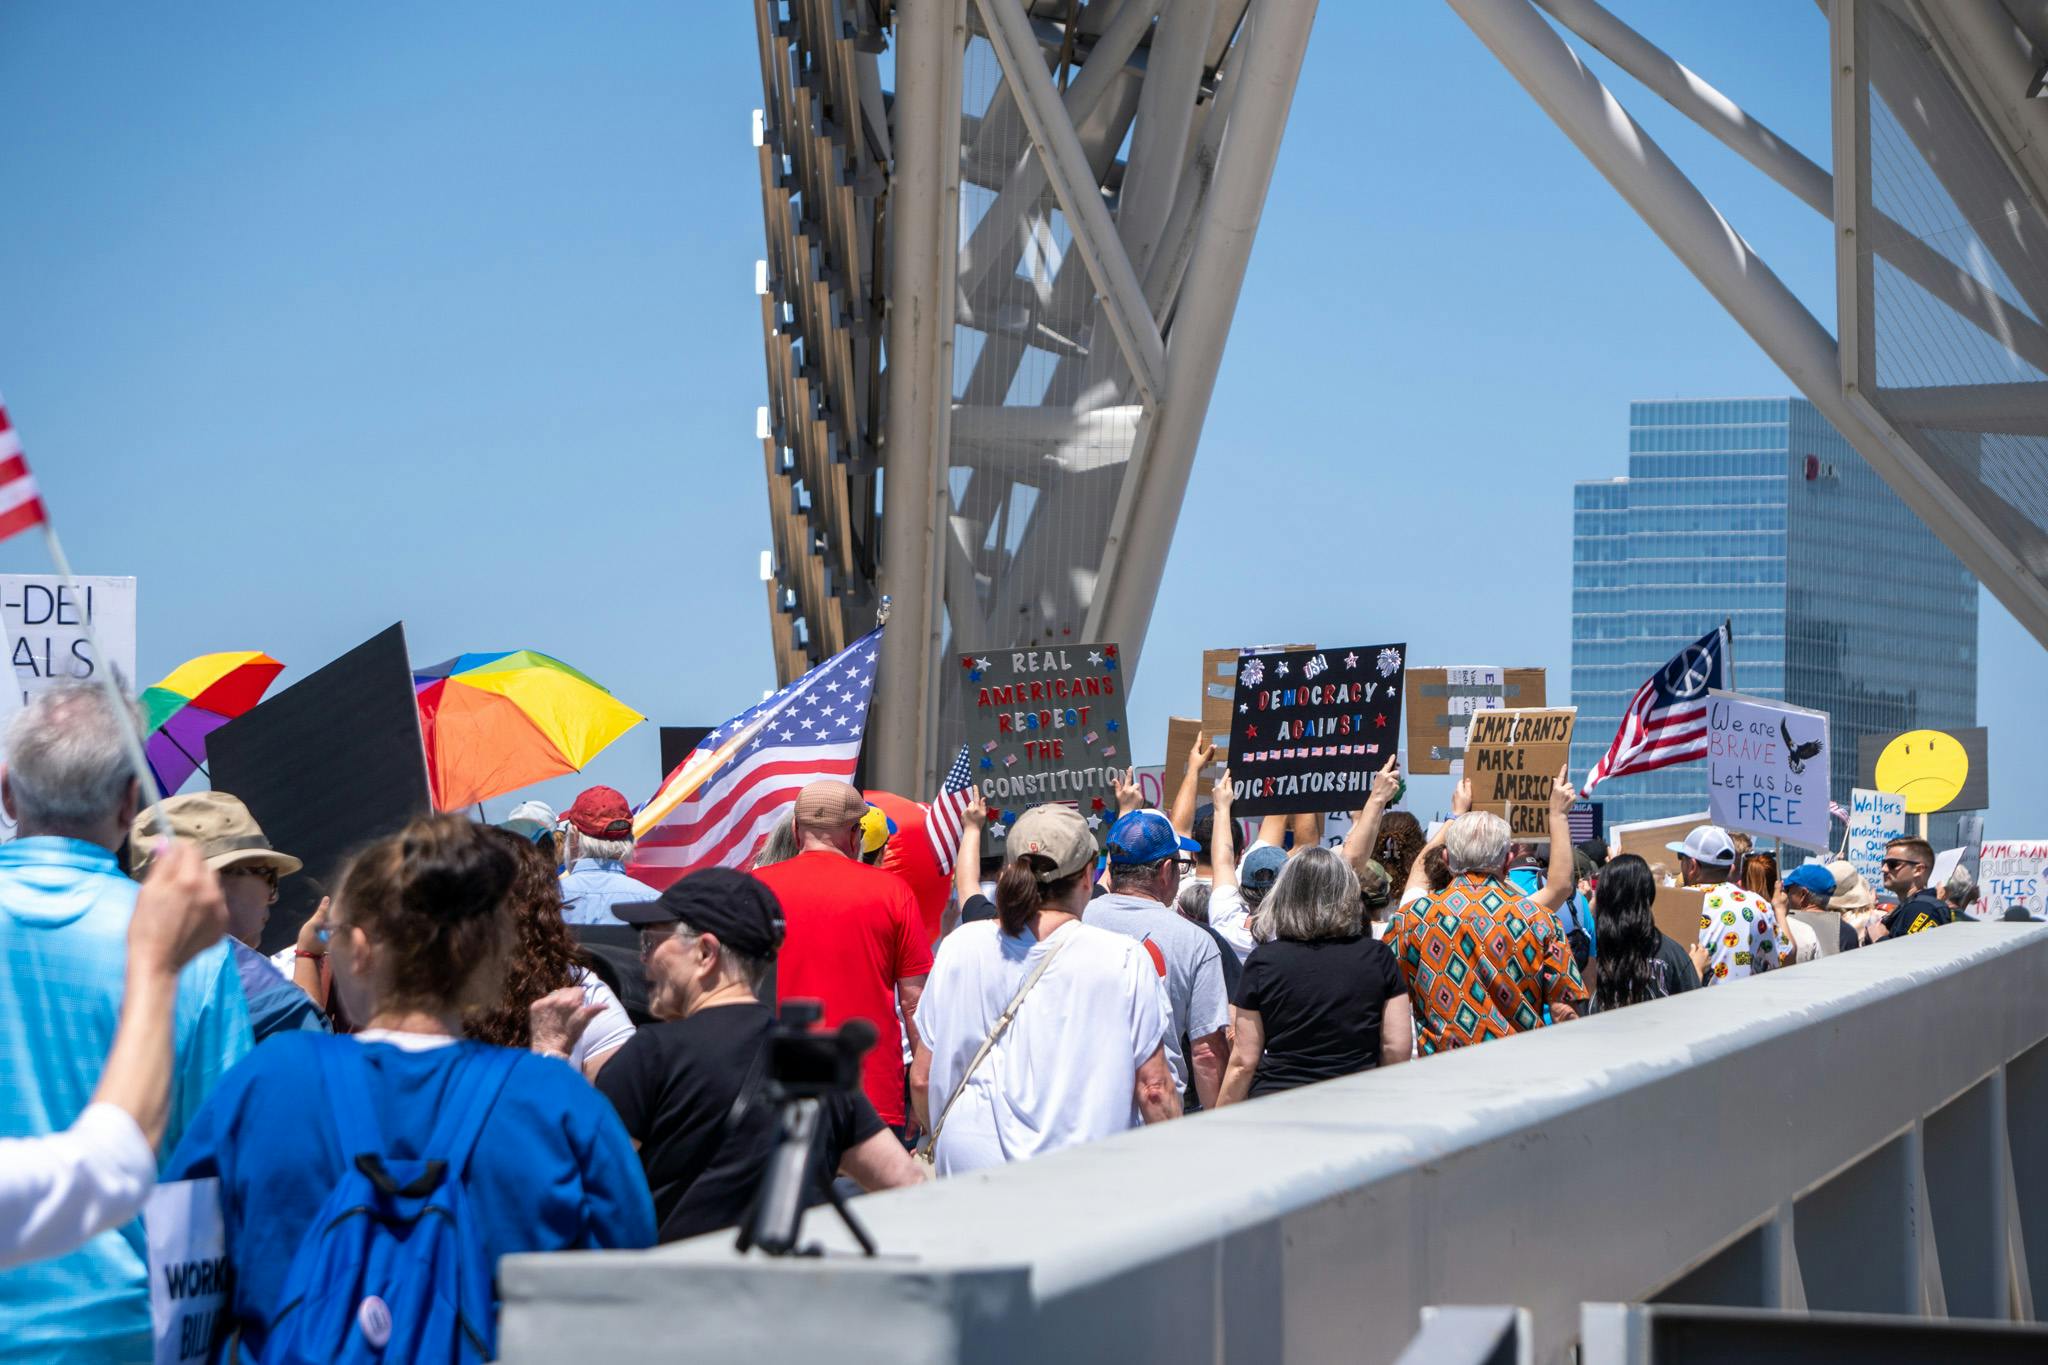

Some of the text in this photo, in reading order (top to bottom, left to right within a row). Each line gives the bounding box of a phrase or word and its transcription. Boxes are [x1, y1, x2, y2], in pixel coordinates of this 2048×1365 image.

[1011, 651, 1072, 673] REAL
[1303, 653, 1329, 680] USA
[977, 675, 1115, 708] AMERICANS
[1258, 682, 1378, 711] DEMOCRACY
[998, 705, 1091, 734] RESPECT
[1277, 714, 1363, 741] AGAINST
[1472, 715, 1571, 743] IMMIGRANTS
[1711, 702, 1776, 738] We are
[1024, 738, 1064, 761] THE
[1477, 749, 1524, 771] MAKE
[1710, 732, 1777, 764] BRAVE
[1712, 762, 1803, 795] Let us be
[1738, 792, 1803, 825] FREE
[1981, 858, 2043, 878] BUILT
[1989, 879, 2037, 896] THIS
